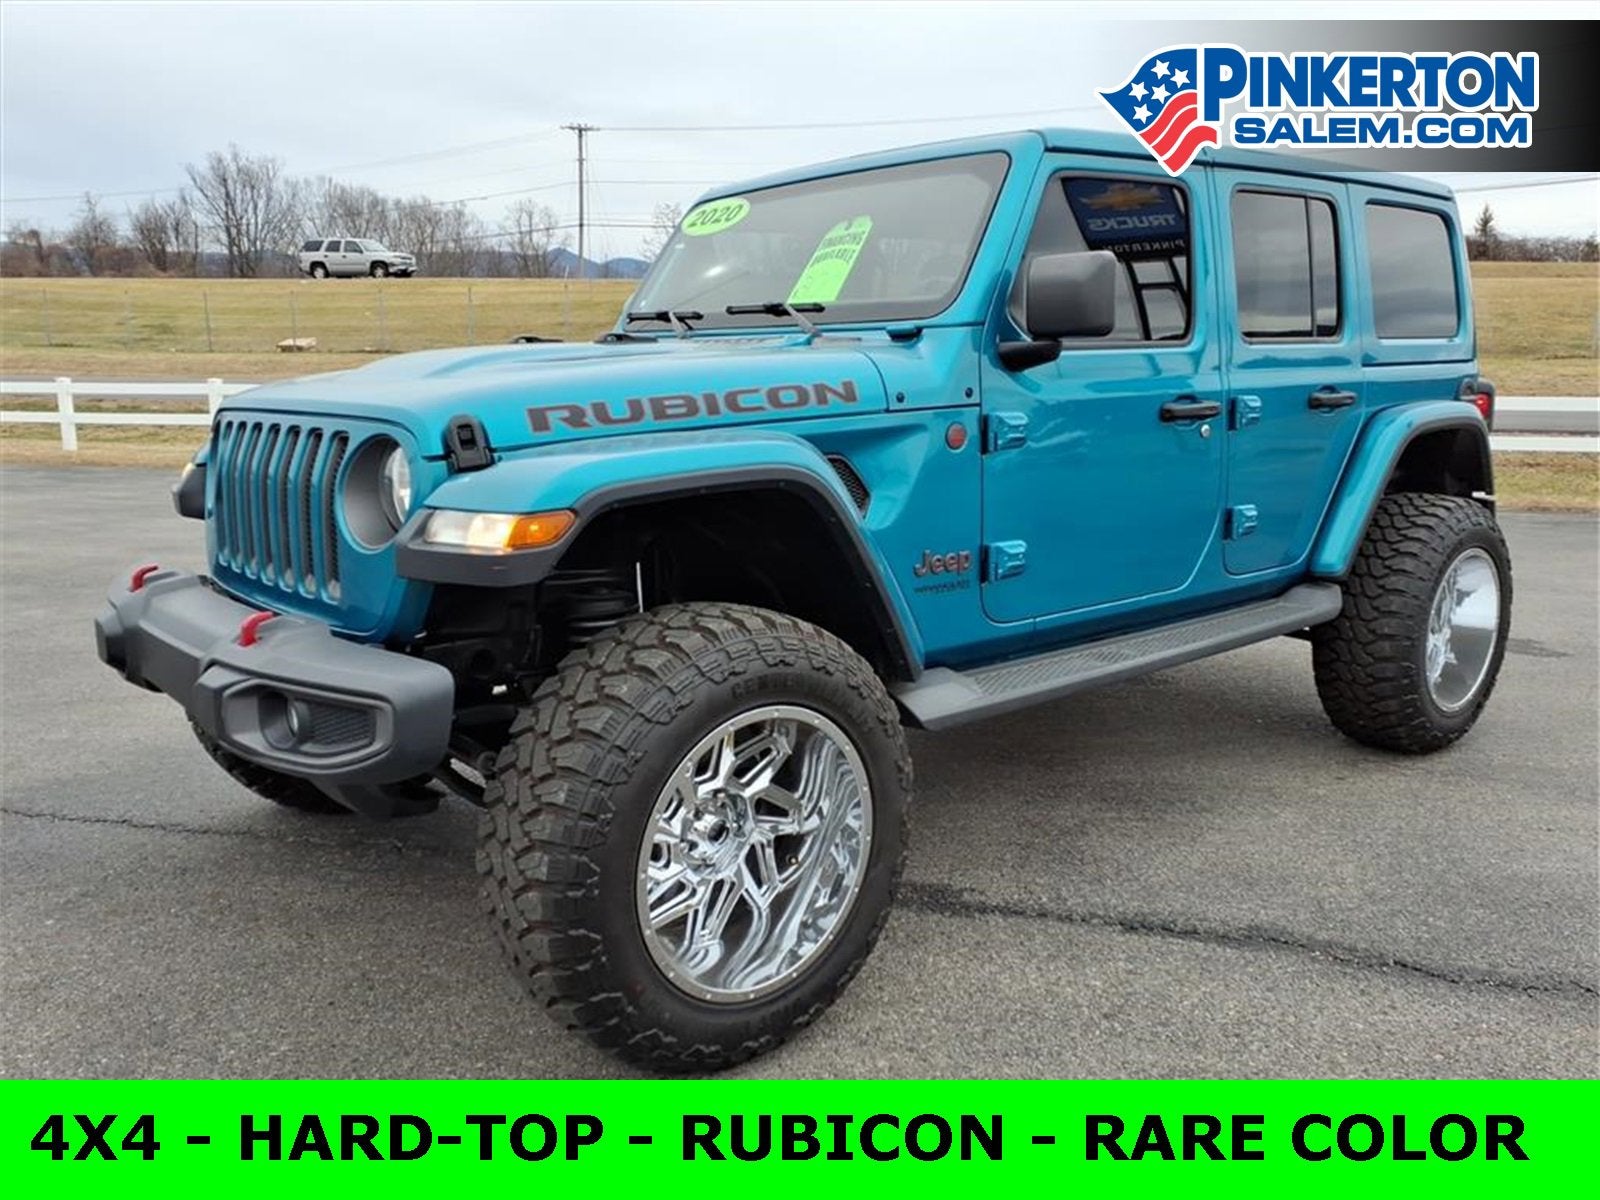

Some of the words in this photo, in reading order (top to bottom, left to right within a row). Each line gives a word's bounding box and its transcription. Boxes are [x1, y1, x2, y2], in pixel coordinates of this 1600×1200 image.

[686, 204, 744, 228] 2020
[526, 380, 859, 433] RUBICON
[913, 549, 972, 577] Jeep
